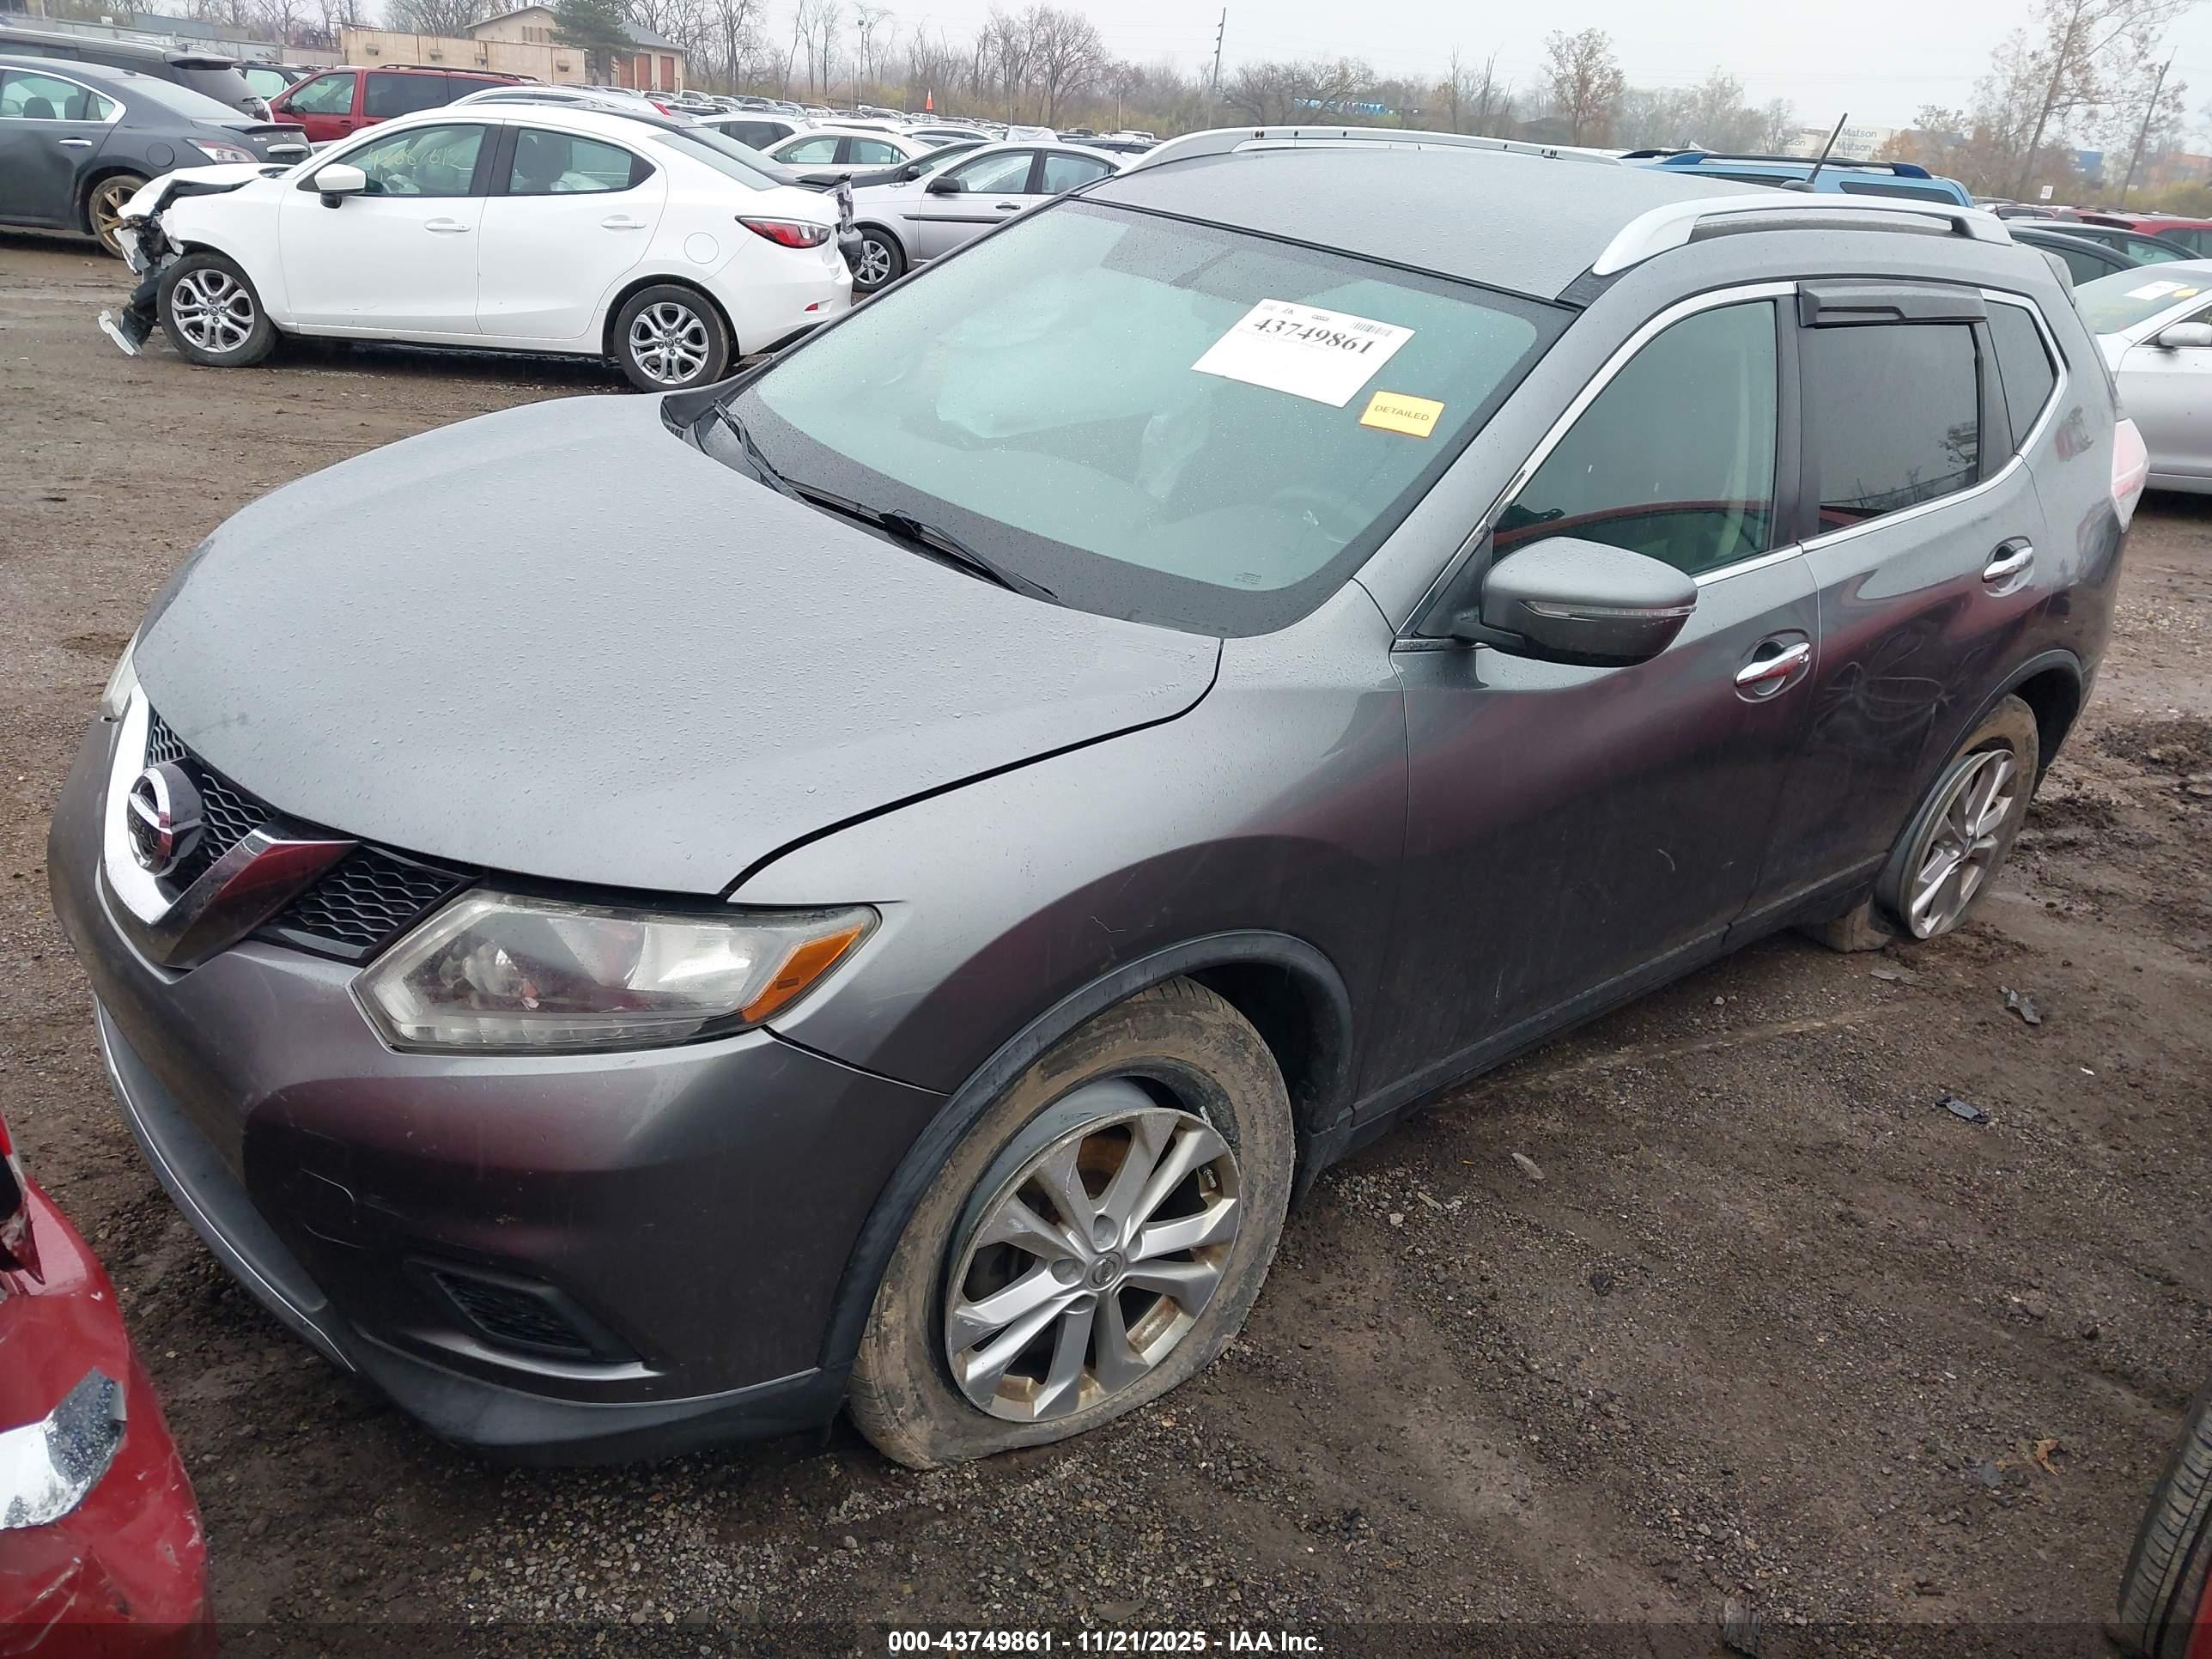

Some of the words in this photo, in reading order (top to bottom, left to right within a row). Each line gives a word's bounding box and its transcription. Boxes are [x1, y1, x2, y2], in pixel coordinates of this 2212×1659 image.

[1841, 128, 1877, 137] Matson
[1836, 142, 1871, 151] Matson
[1254, 317, 1376, 355] 43749861
[1374, 404, 1430, 421] DETAILED
